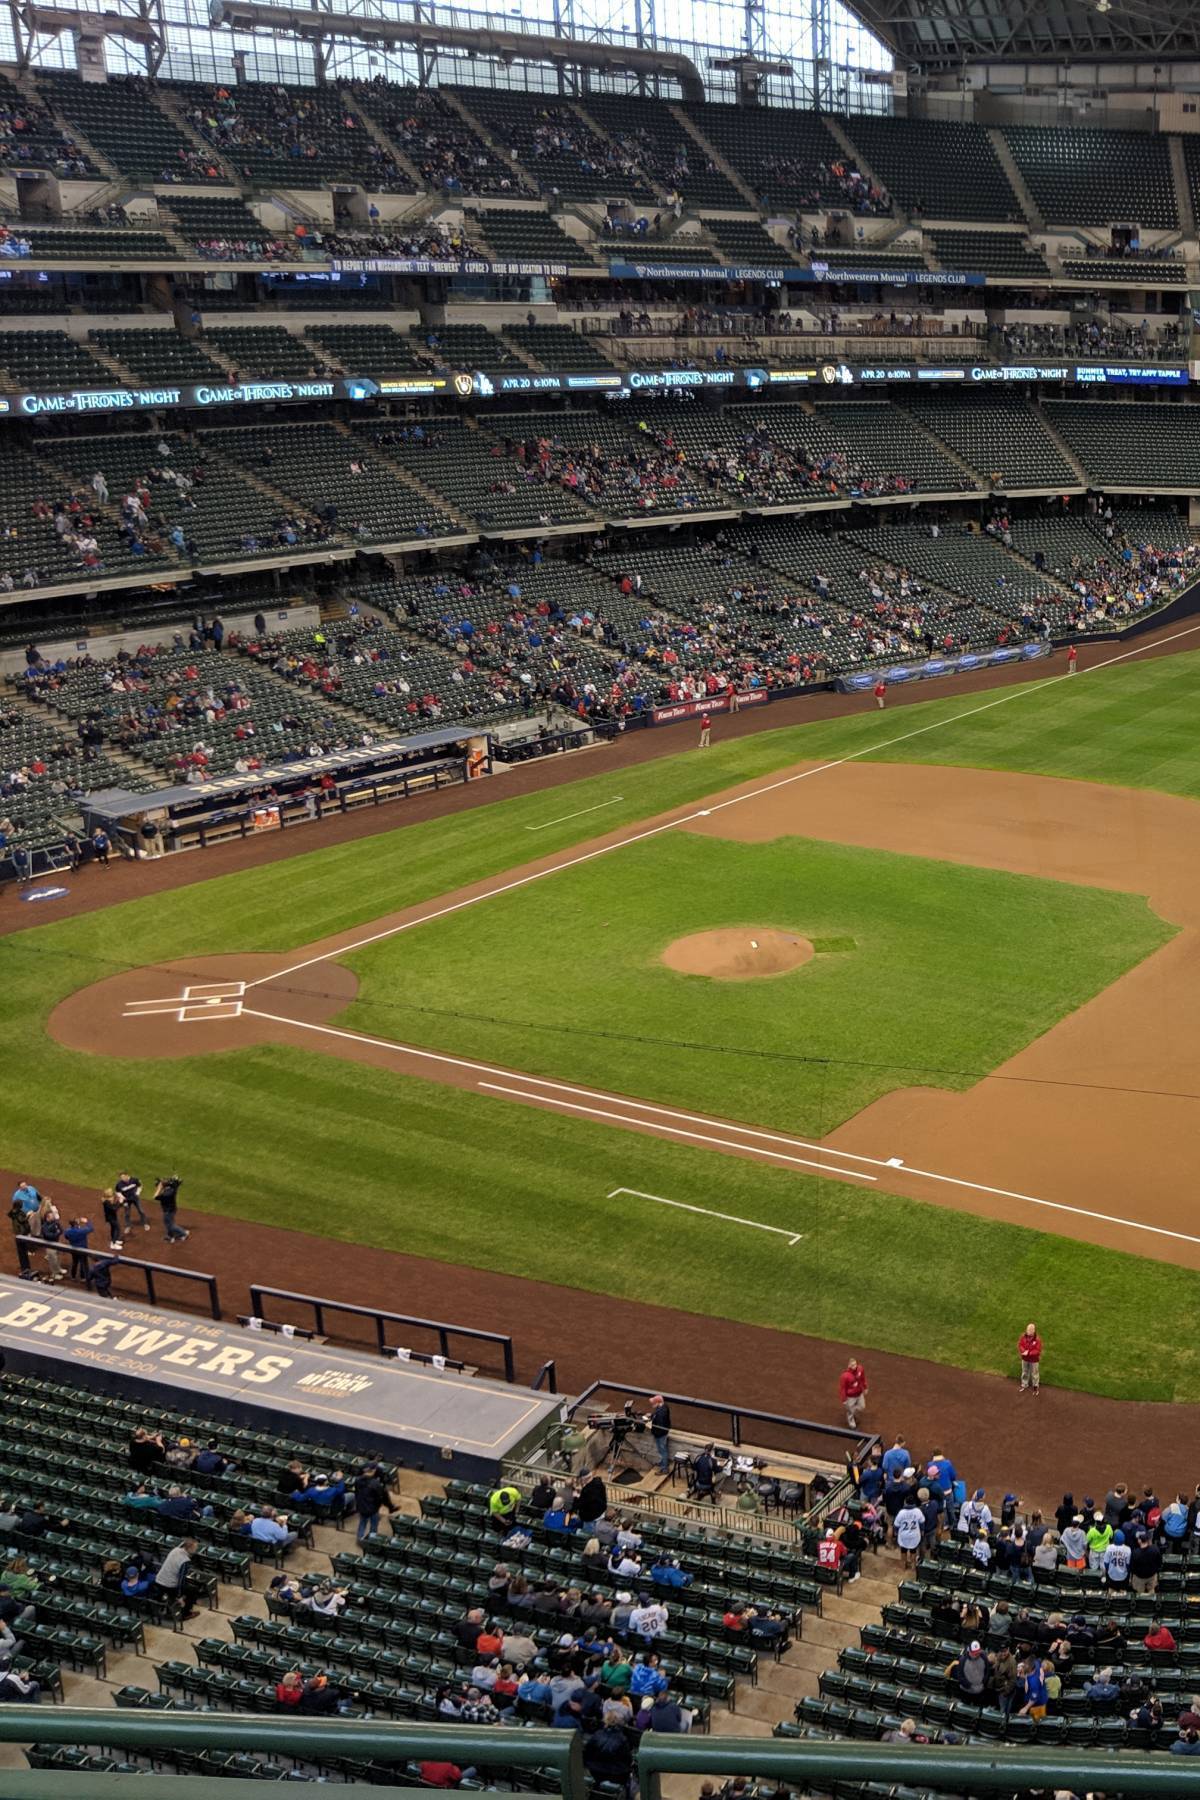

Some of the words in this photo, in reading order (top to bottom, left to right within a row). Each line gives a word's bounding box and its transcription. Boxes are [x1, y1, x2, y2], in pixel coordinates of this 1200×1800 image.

[646, 267, 699, 278] Northwestern
[700, 268, 729, 279] Mutual
[735, 268, 766, 279] LEGENDS
[767, 270, 784, 279] CLUB
[825, 271, 878, 282] Northwestern
[880, 272, 908, 283] Mutual
[915, 273, 947, 283] LEGENDS
[948, 275, 966, 284] CLUB
[631, 373, 659, 387] GAME
[662, 371, 703, 386] THRONES
[706, 372, 735, 384] NIGHT
[861, 371, 876, 379] APR
[877, 371, 885, 379] 20
[972, 368, 998, 380] GAME
[1001, 367, 1038, 380] THRONES
[1041, 368, 1068, 379] NIGHT
[503, 377, 519, 387] APR
[520, 378, 530, 388] 20
[196, 387, 234, 404] GAME
[240, 383, 292, 402] THRONES
[299, 383, 335, 397] NIGHT
[22, 396, 66, 414] GAME
[73, 391, 133, 410] THRONES
[140, 391, 181, 405] NIGHT
[116, 1308, 161, 1326] HOME
[166, 1318, 190, 1330] OF
[194, 1323, 226, 1337] THE
[0, 1301, 294, 1383] BREWERS
[70, 1347, 120, 1366] SINCE
[120, 1357, 159, 1375] 2001
[297, 1372, 332, 1386] MY
[322, 1377, 374, 1393] CREW
[902, 1520, 917, 1531] 22
[820, 1549, 836, 1563] 24
[641, 1618, 658, 1633] 20
